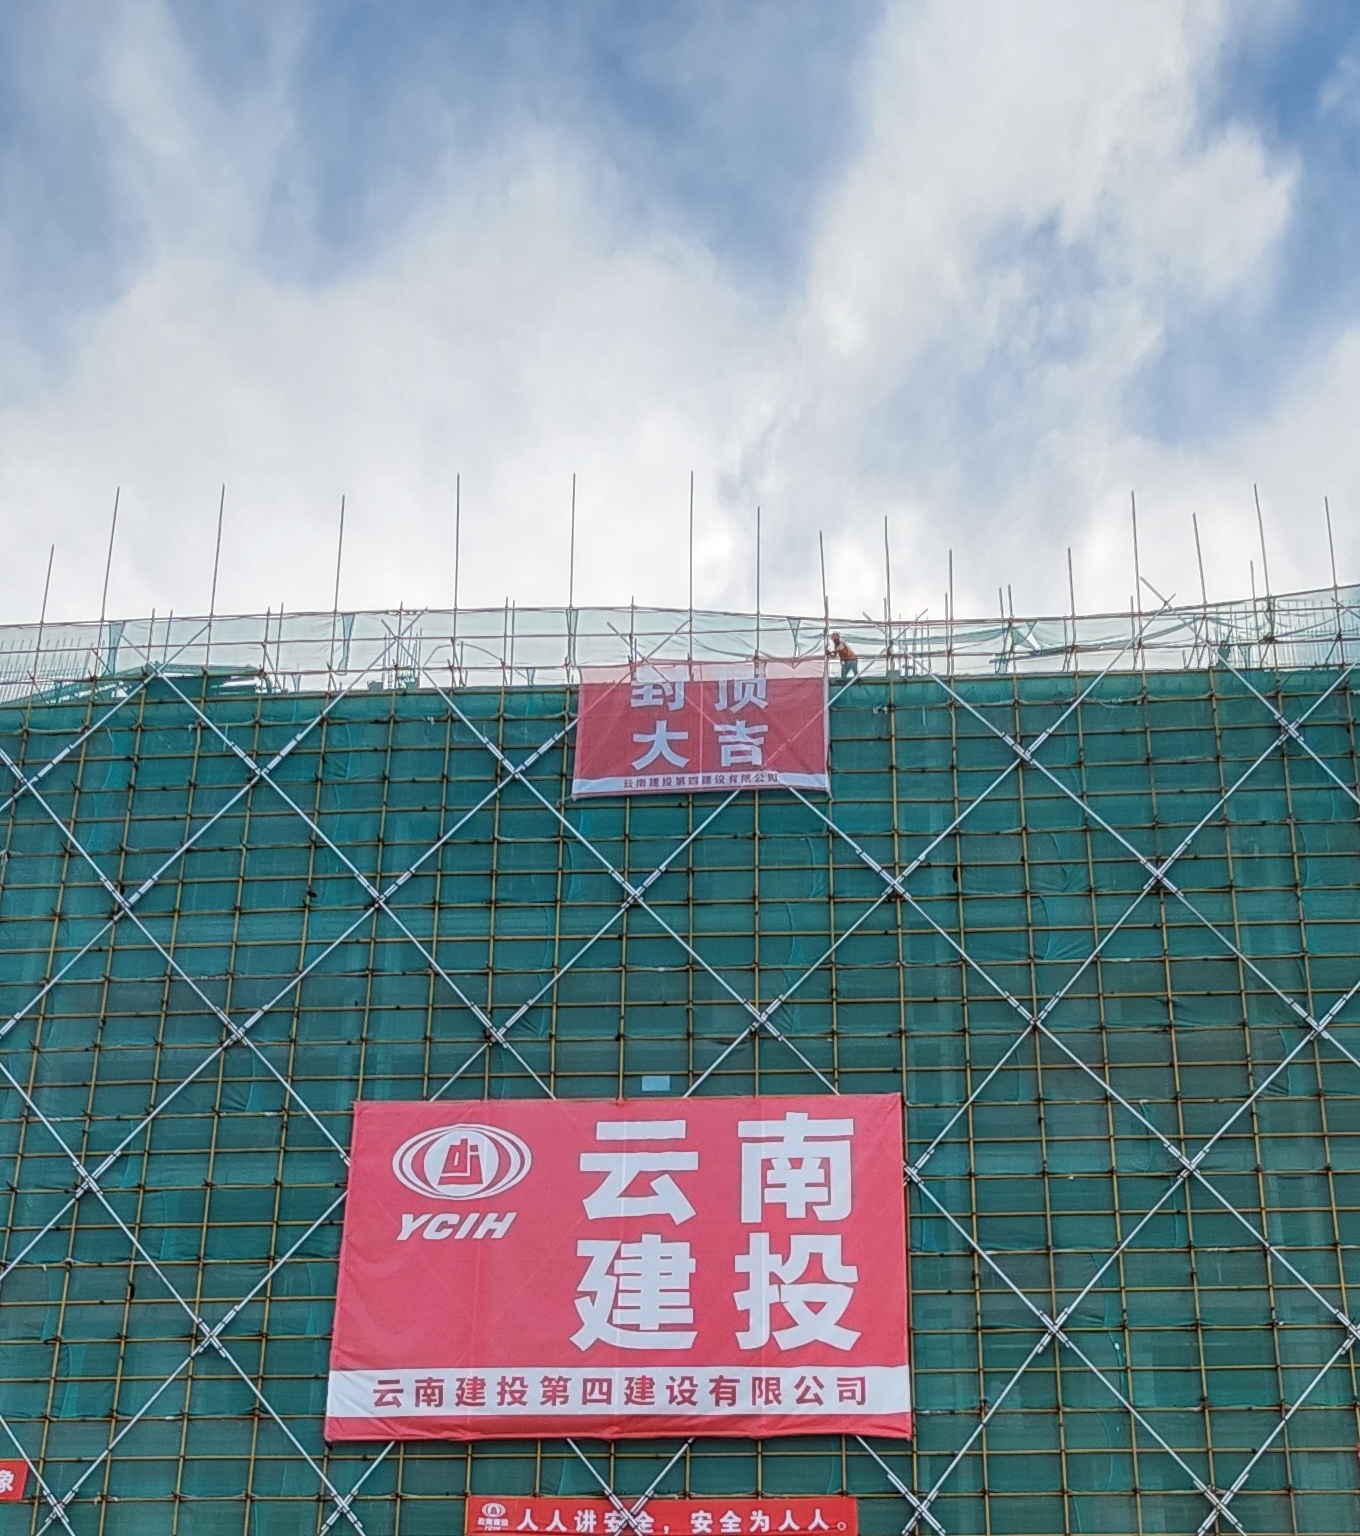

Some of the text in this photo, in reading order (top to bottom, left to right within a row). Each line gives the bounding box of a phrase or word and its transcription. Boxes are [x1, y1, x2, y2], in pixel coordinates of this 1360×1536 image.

[631, 720, 770, 770] 大吉
[579, 1112, 854, 1225] 云南
[396, 1212, 517, 1241] YCIH
[570, 1232, 861, 1352] 建投
[373, 1374, 868, 1408] 云南建投第四建设有限公司
